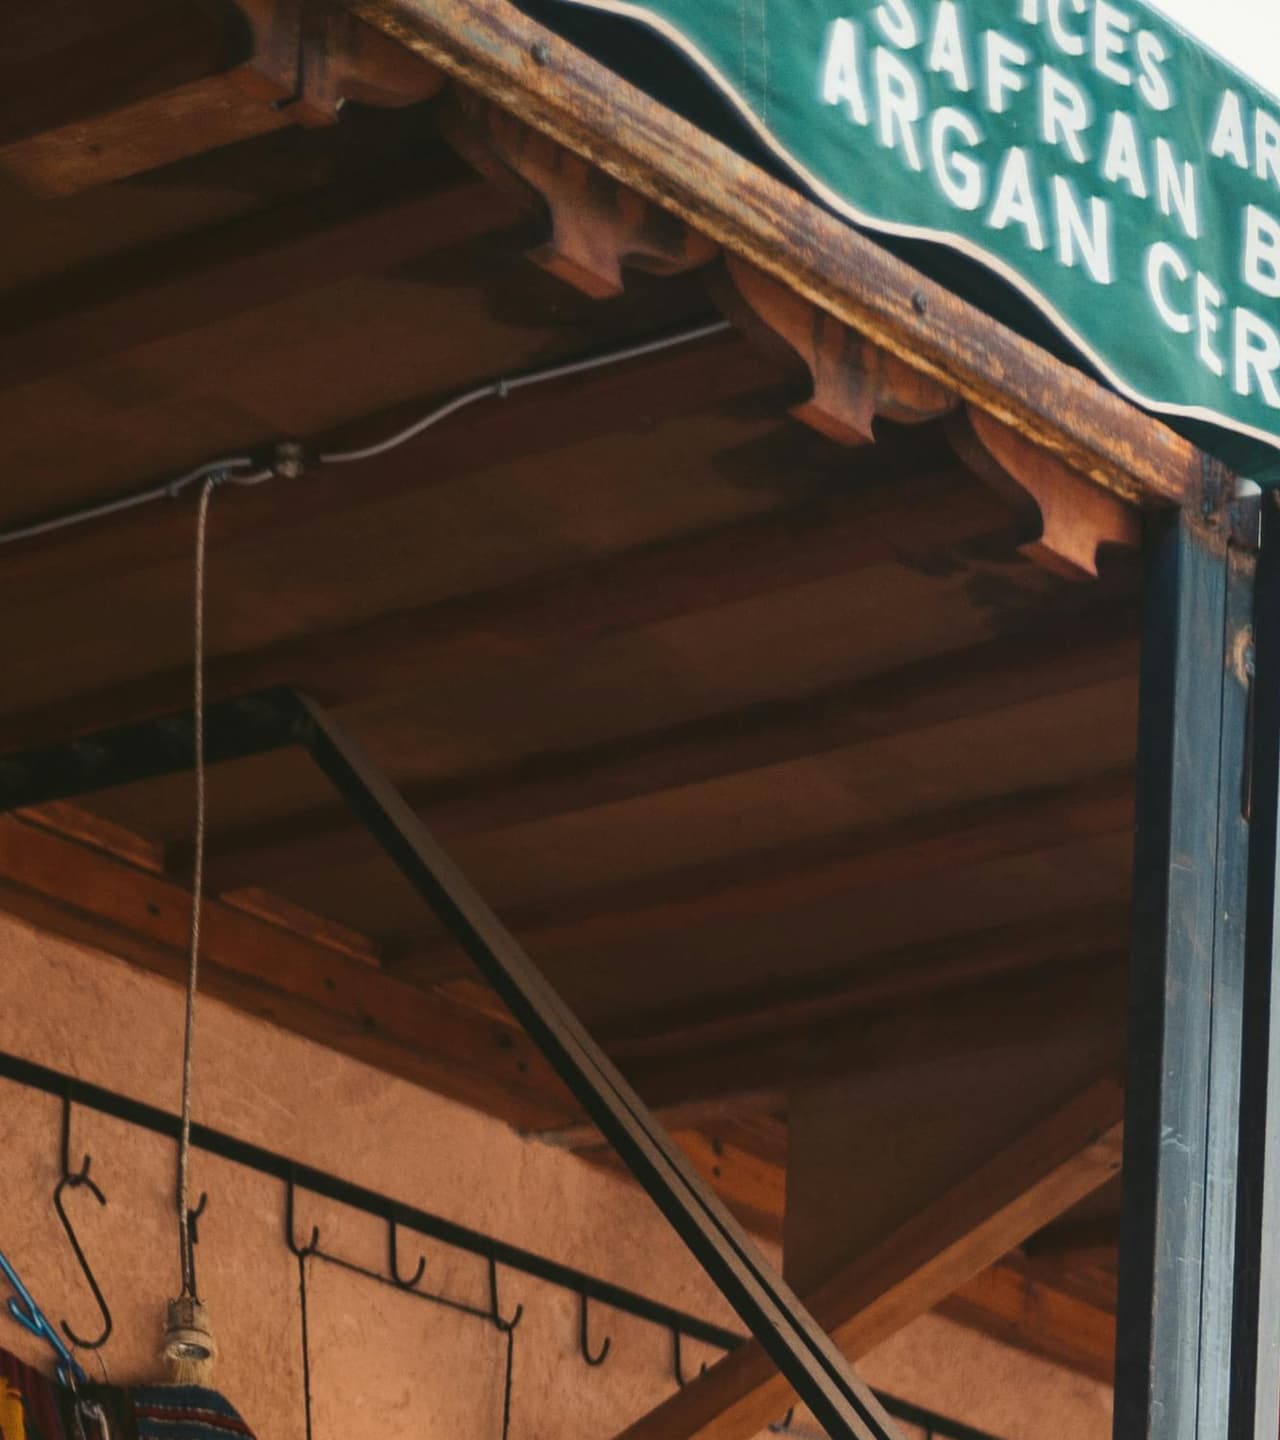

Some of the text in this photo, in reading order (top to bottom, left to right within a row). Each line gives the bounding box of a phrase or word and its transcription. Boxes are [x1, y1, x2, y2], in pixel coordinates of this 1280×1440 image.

[821, 15, 1114, 286] ARGAN
[874, 0, 1199, 241] SAFRAN
[1021, 0, 1172, 111] CES
